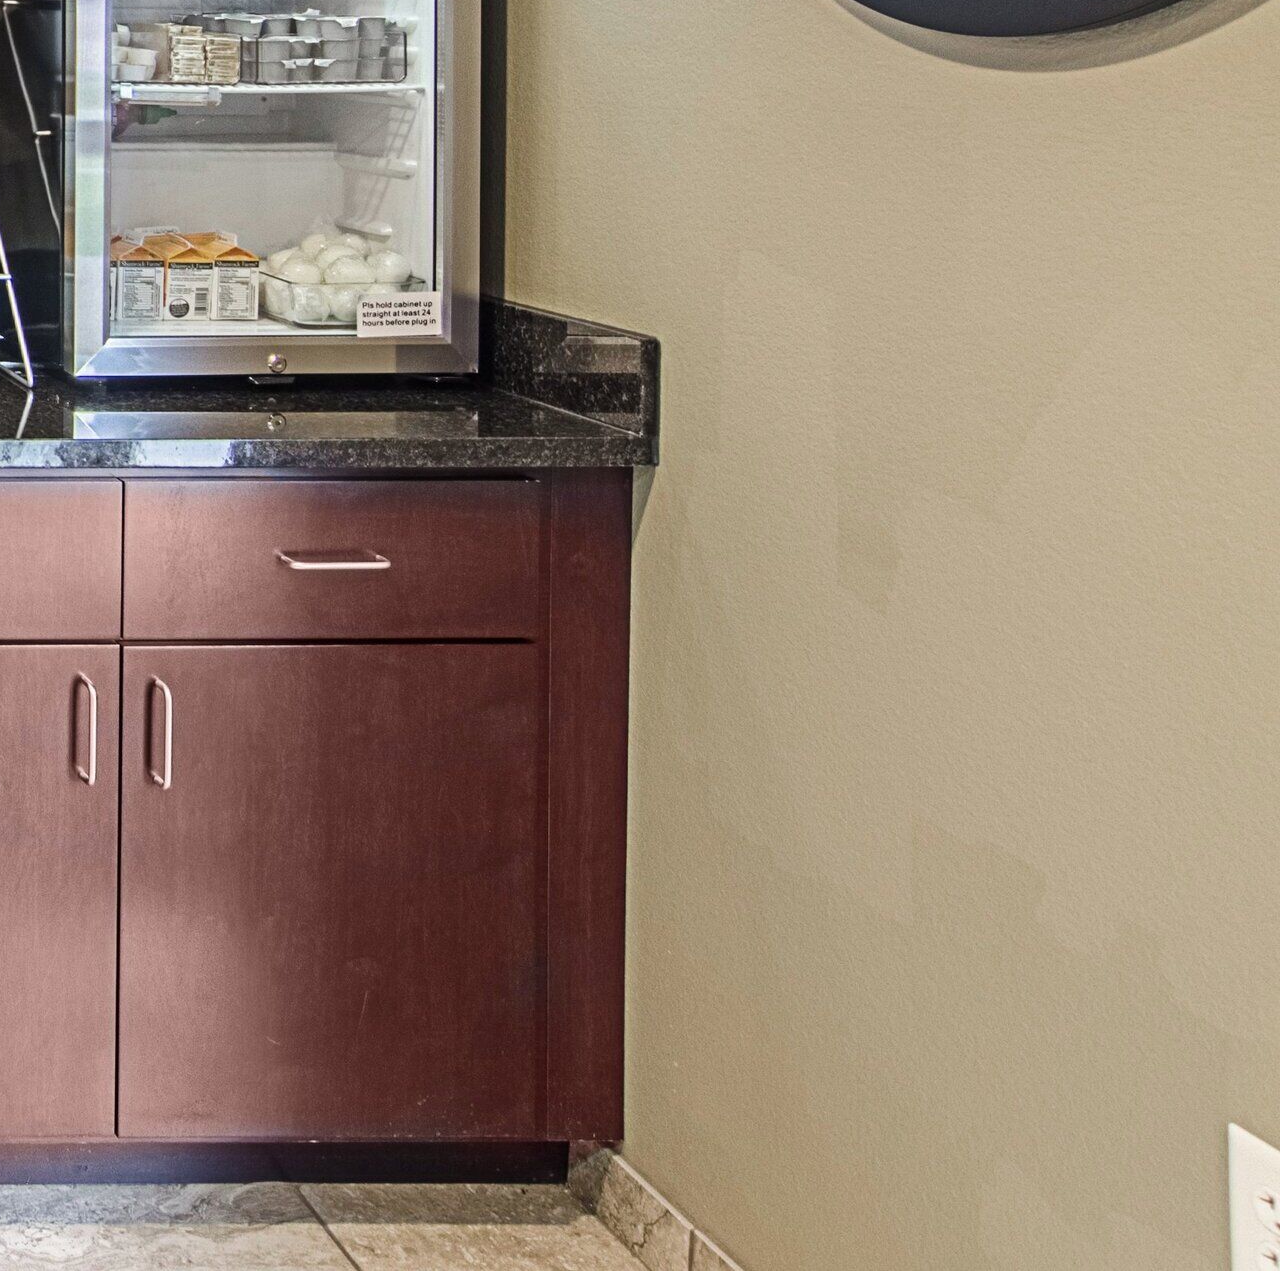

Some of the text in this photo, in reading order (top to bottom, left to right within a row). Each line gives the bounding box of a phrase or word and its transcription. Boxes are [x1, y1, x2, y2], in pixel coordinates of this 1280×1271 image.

[362, 301, 374, 309] Pls
[393, 300, 422, 308] cabinet
[362, 310, 391, 318] straight
[385, 318, 410, 326] before
[411, 318, 428, 326] plug
